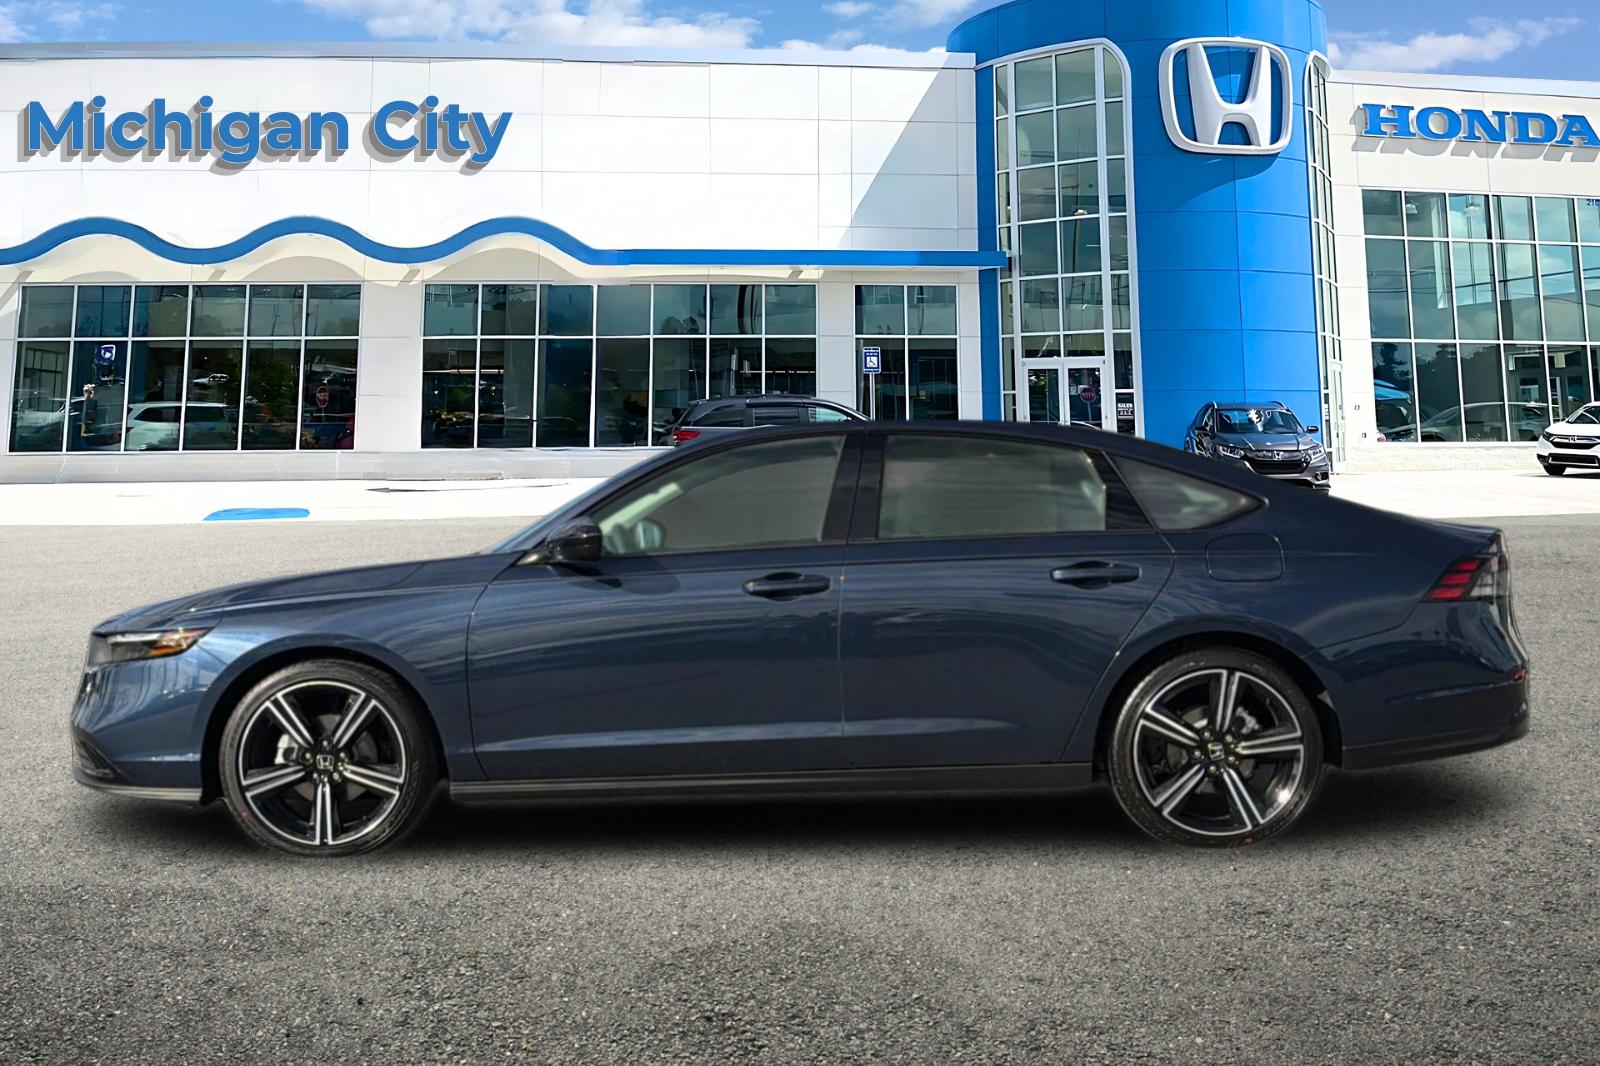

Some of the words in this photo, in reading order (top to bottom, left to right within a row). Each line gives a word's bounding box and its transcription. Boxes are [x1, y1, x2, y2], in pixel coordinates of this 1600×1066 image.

[28, 95, 349, 164] Michigan
[373, 96, 513, 164] City
[1361, 103, 1600, 147] HONDA
